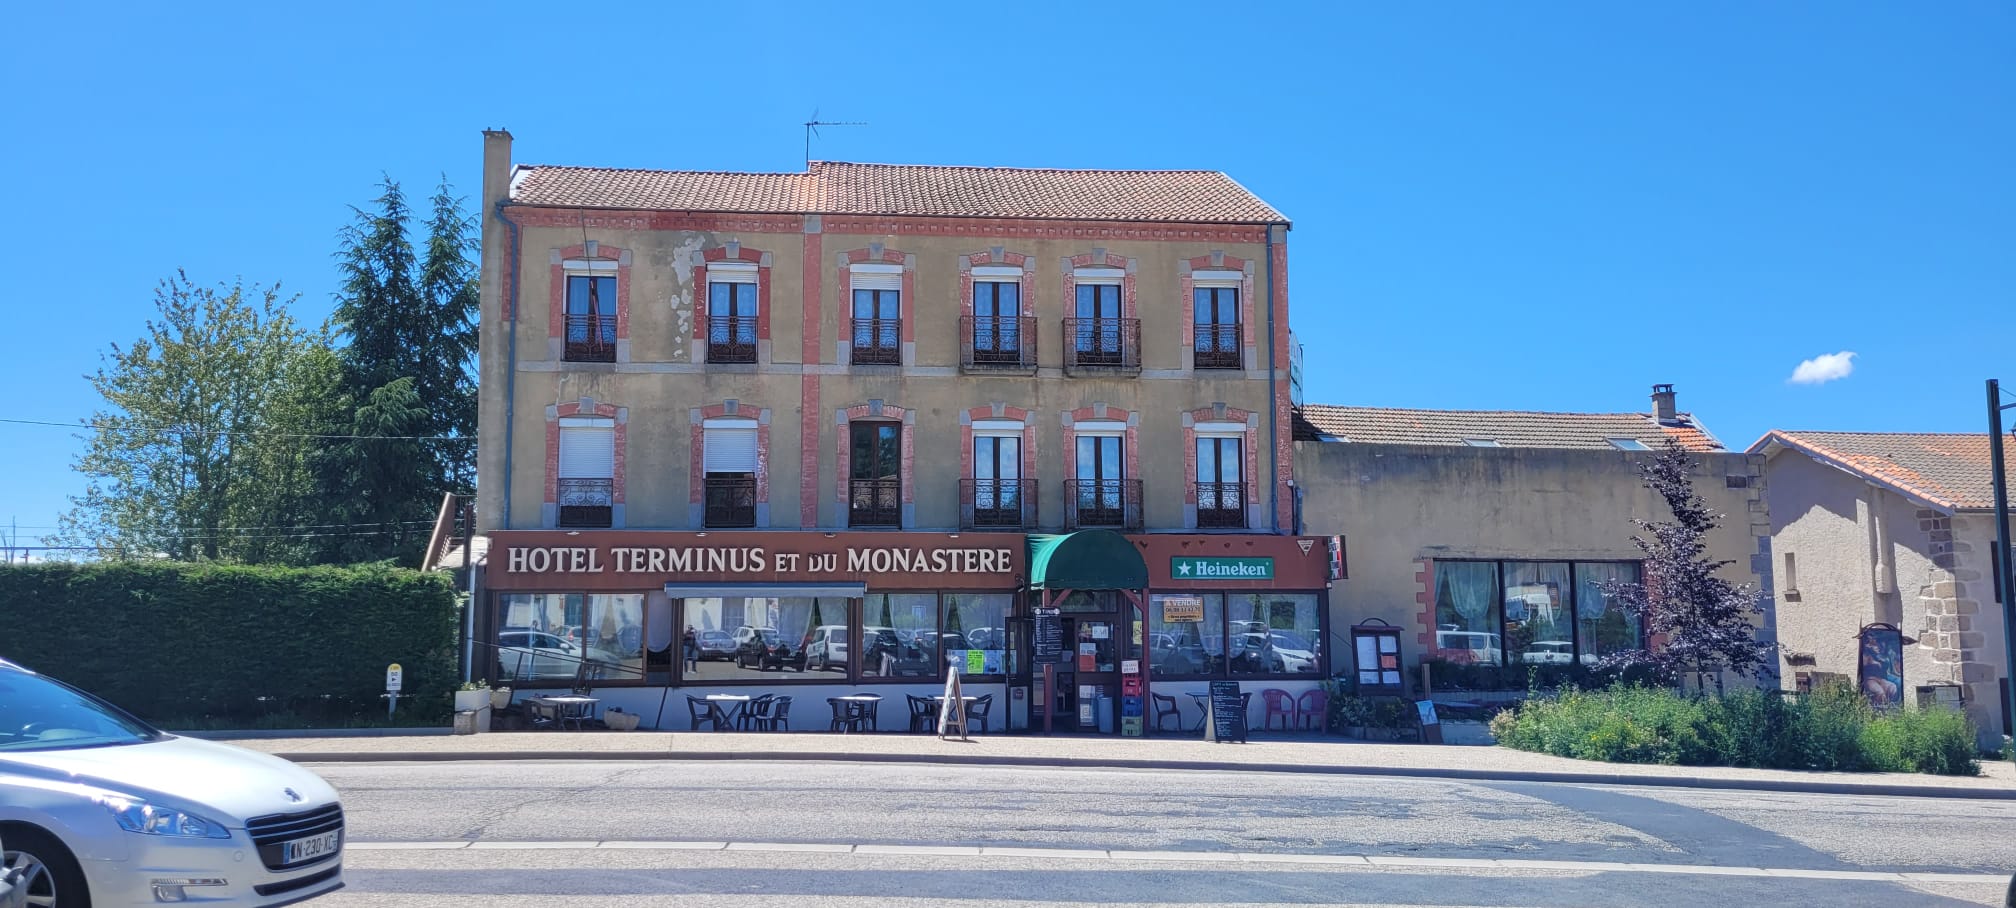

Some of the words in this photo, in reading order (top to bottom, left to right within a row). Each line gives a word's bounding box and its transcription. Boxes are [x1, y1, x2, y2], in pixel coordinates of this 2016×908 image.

[507, 547, 604, 573] HOTEL
[611, 547, 765, 573] TERMINUS
[775, 553, 799, 573] ET
[808, 553, 837, 573] DU
[847, 547, 1012, 573] MONASTERE
[1195, 561, 1267, 576] Heineken
